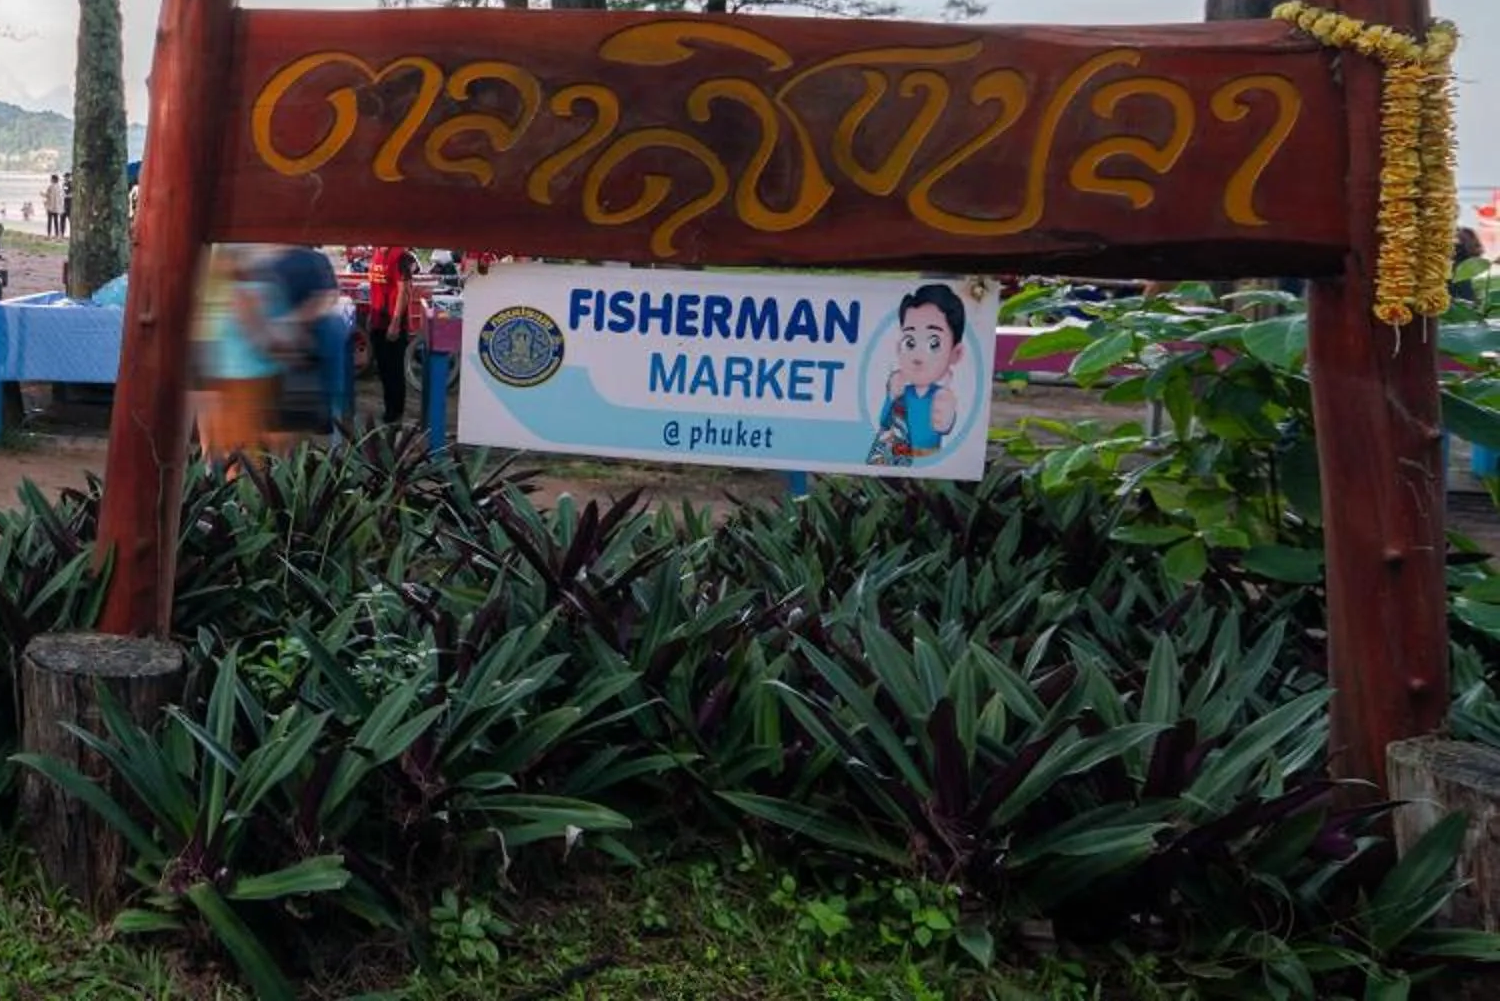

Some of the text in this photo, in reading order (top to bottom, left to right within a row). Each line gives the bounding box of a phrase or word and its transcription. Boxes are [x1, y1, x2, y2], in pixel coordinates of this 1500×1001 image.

[569, 288, 861, 344] FISHERMAN
[648, 352, 845, 403] MARKET
[689, 418, 773, 450] phuket
